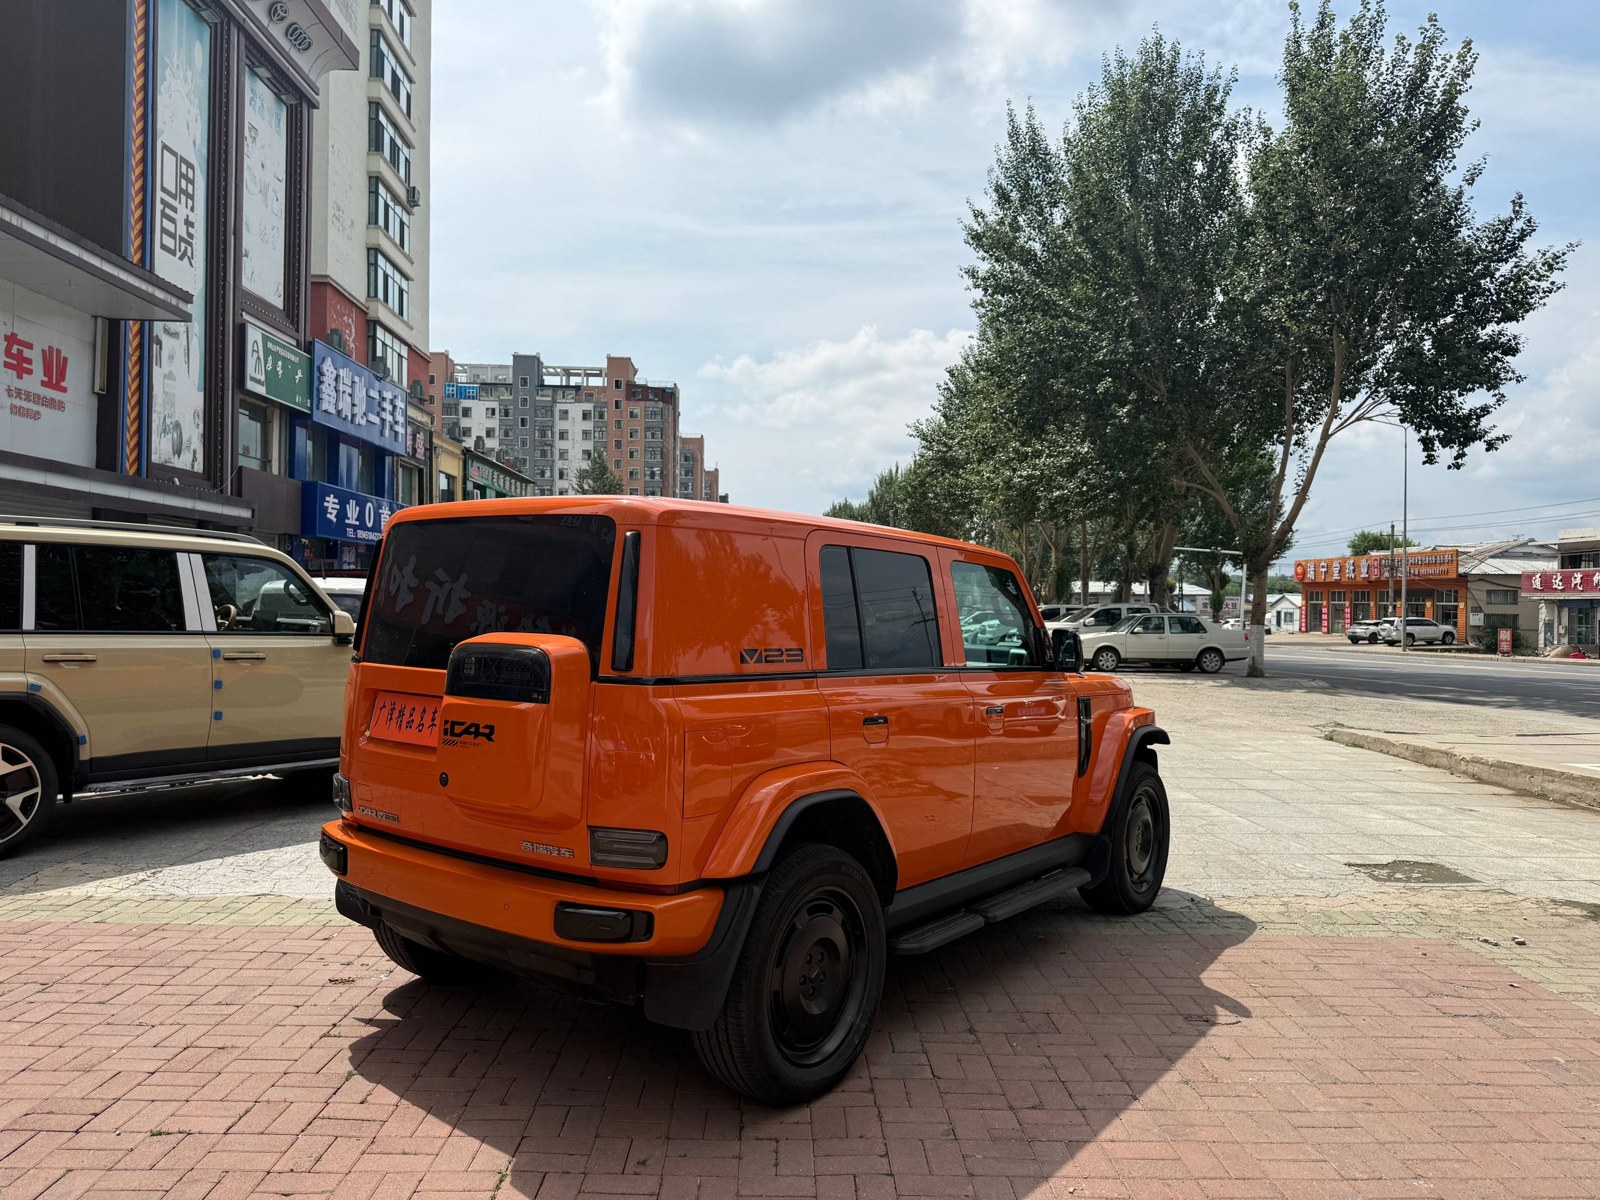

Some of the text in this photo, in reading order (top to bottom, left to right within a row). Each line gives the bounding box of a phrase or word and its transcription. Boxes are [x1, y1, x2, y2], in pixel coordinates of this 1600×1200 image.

[3, 332, 69, 394] 车业
[739, 648, 804, 665] V23
[520, 840, 575, 859] 奇瑞汽车
